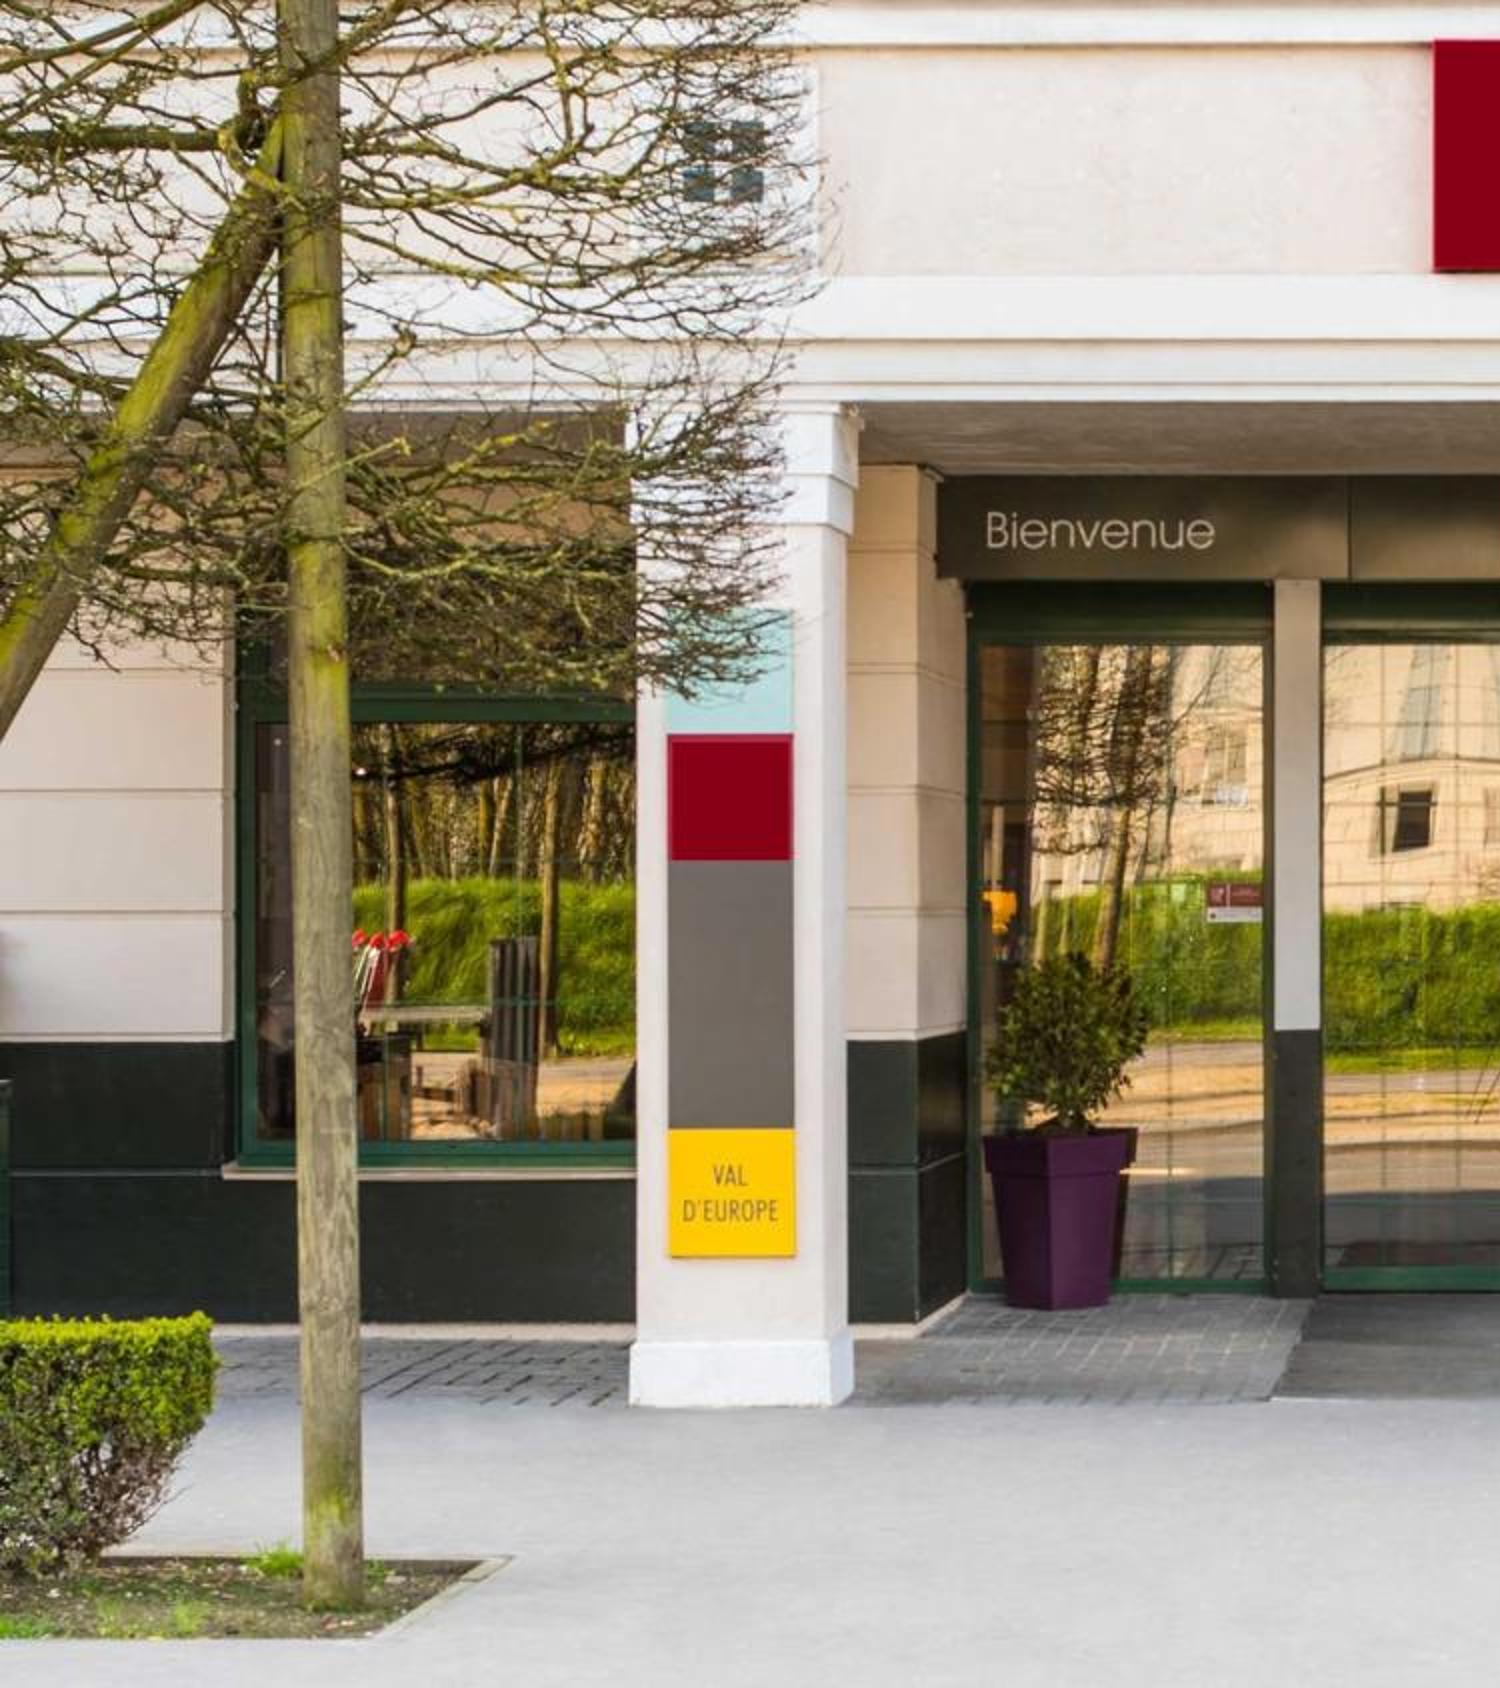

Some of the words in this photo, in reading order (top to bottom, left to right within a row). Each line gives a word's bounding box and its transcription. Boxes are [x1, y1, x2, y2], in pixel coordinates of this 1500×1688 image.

[986, 511, 1216, 550] Bienvenue
[712, 1163, 748, 1187] VAL
[683, 1199, 779, 1222] D'EUROPE
